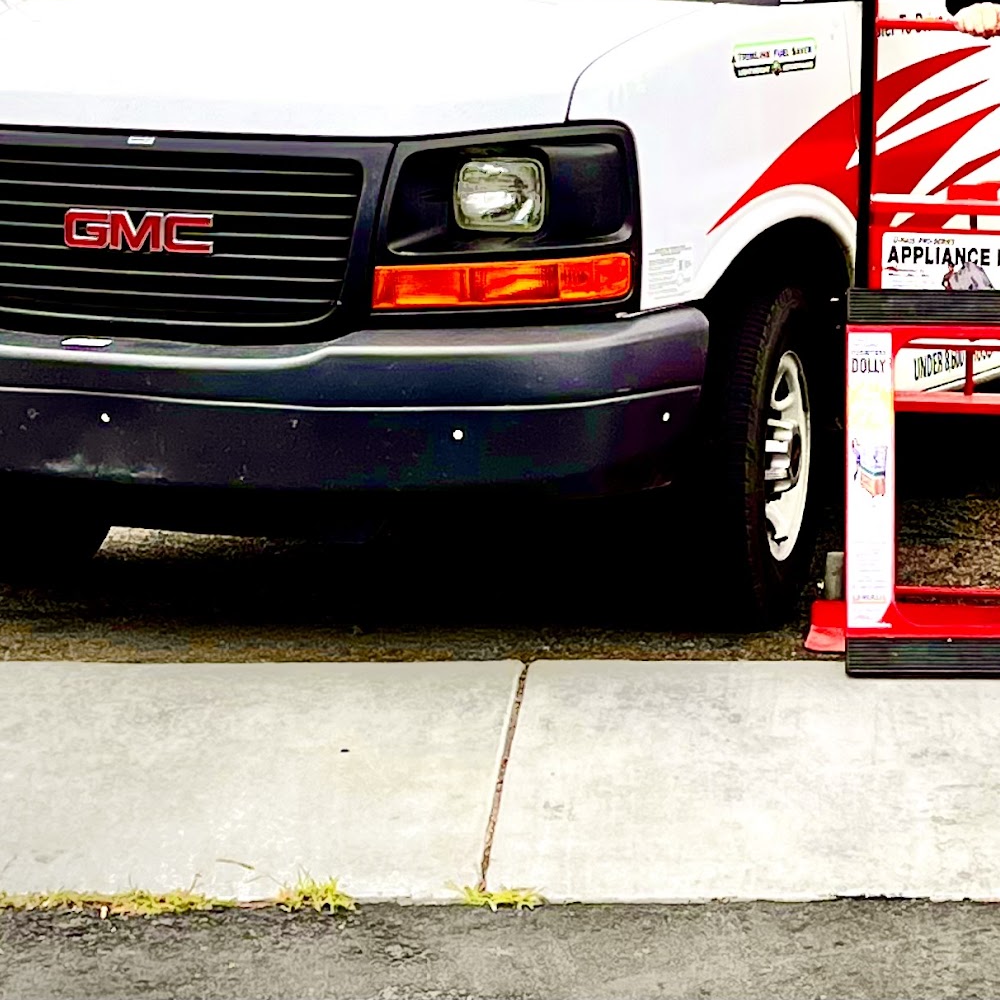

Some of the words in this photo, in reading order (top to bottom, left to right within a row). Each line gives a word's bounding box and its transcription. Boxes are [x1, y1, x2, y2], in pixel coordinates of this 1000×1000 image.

[64, 208, 215, 254] GMC
[887, 245, 990, 266] APPLIANCE
[851, 358, 886, 374] DOLLY
[914, 351, 943, 381] UNDER
